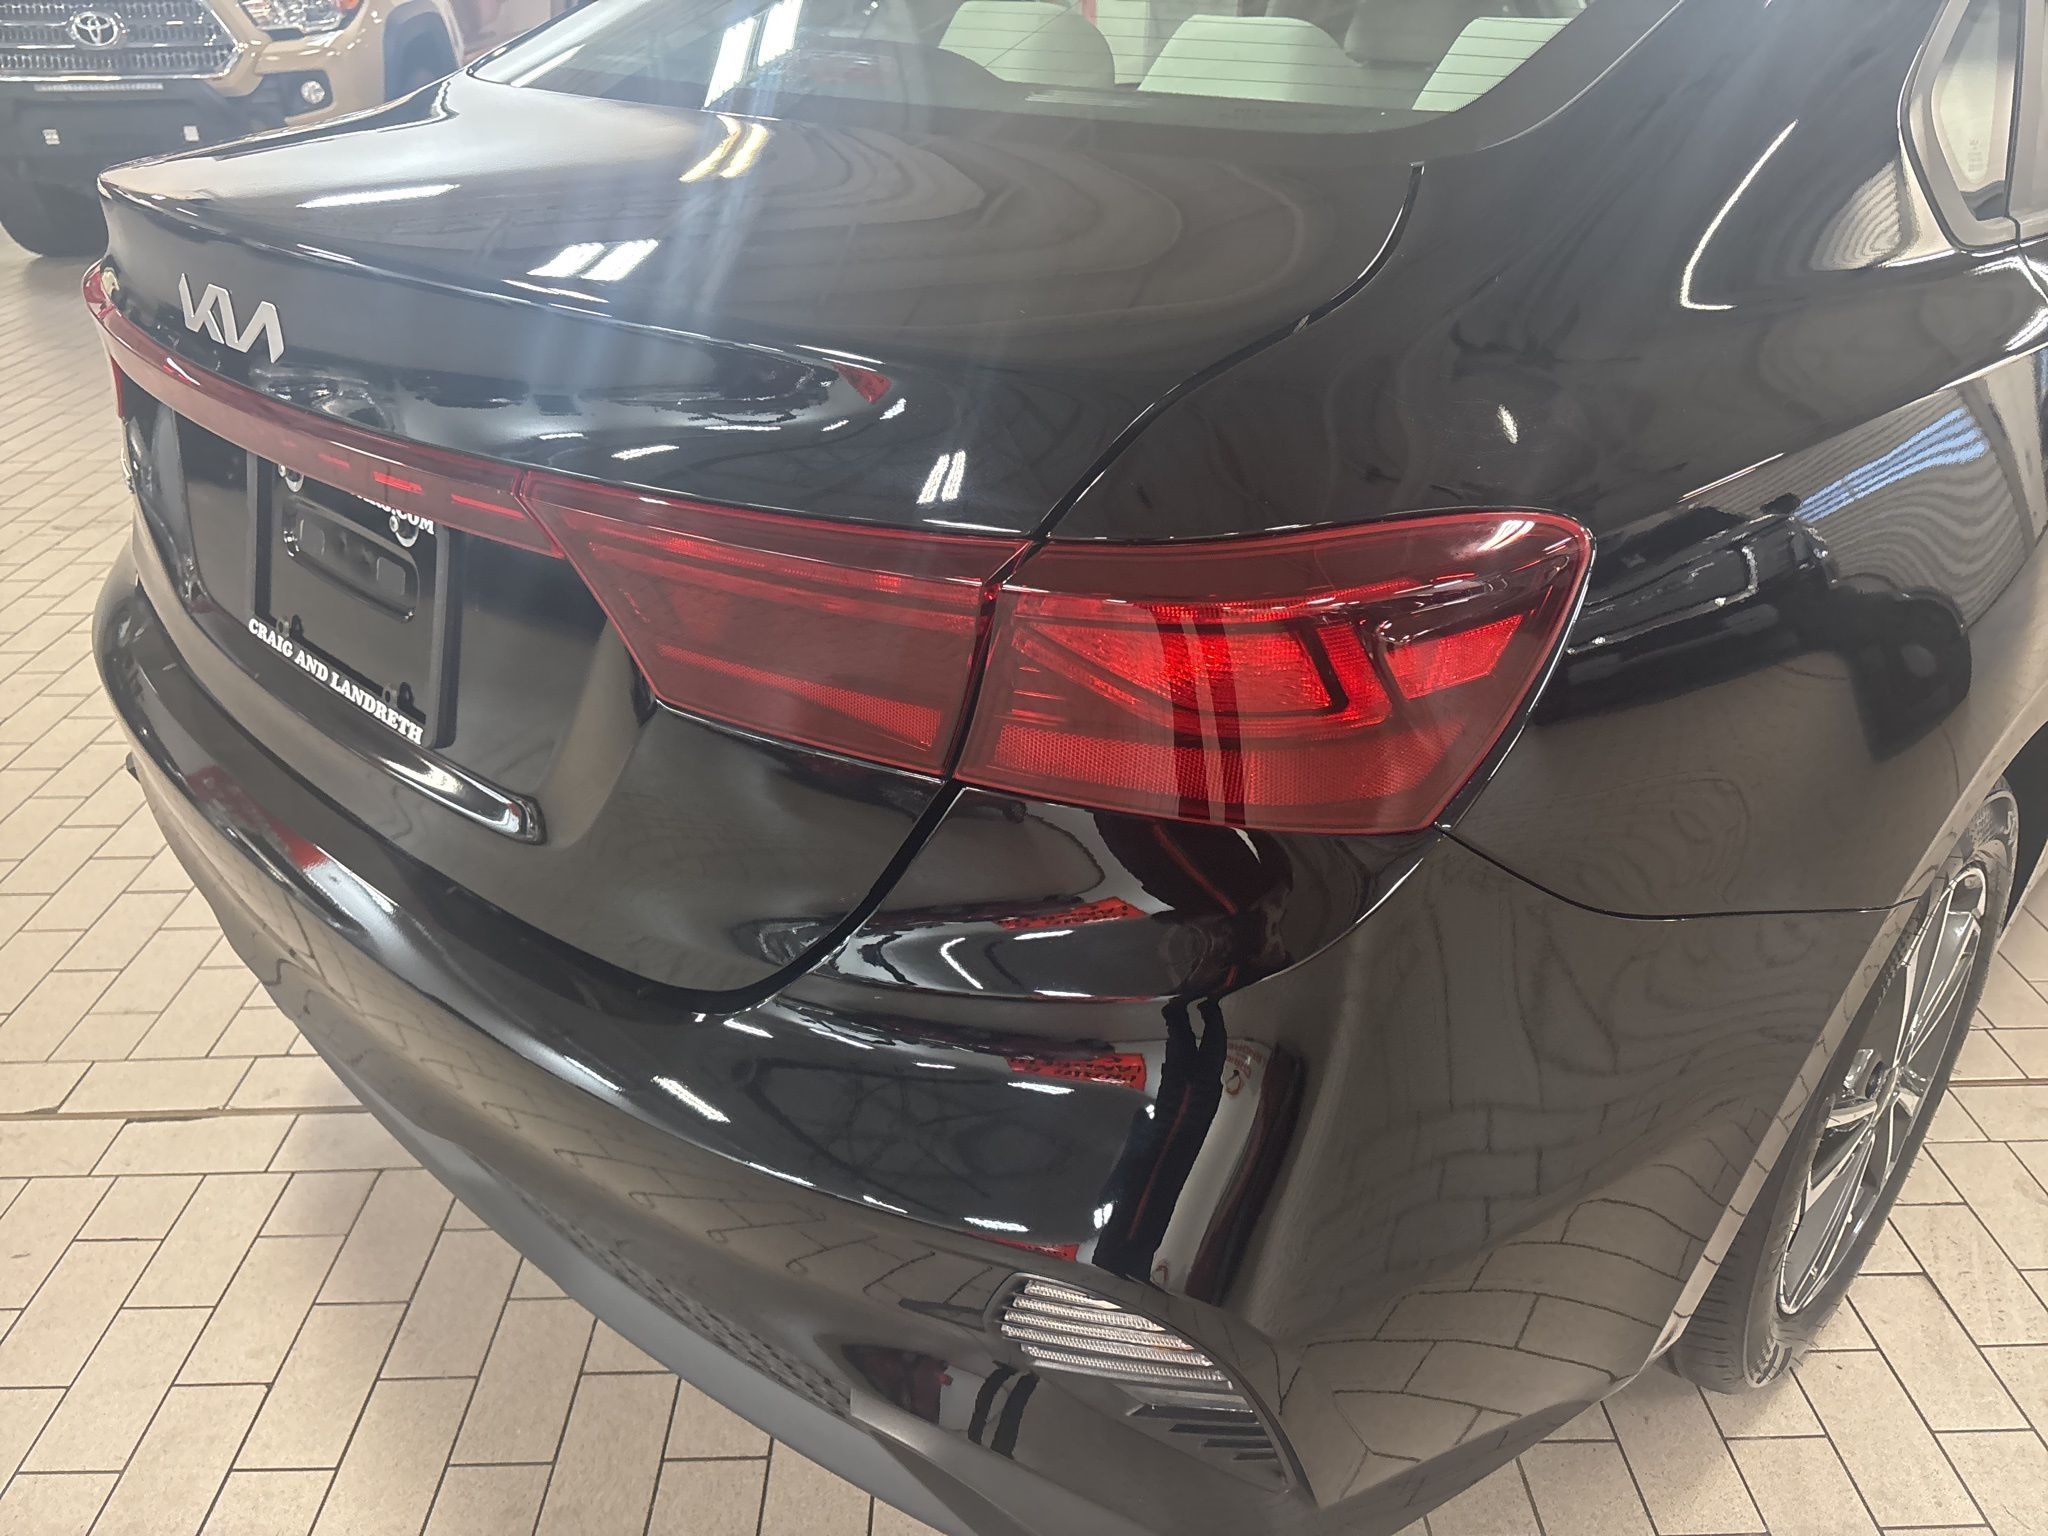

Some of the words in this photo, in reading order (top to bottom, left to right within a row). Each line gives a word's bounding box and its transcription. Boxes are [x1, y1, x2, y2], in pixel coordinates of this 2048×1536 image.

[178, 272, 285, 364] KIA
[248, 618, 294, 658] CRAIG
[294, 649, 329, 682] AND
[329, 671, 424, 745] LANDRETH
